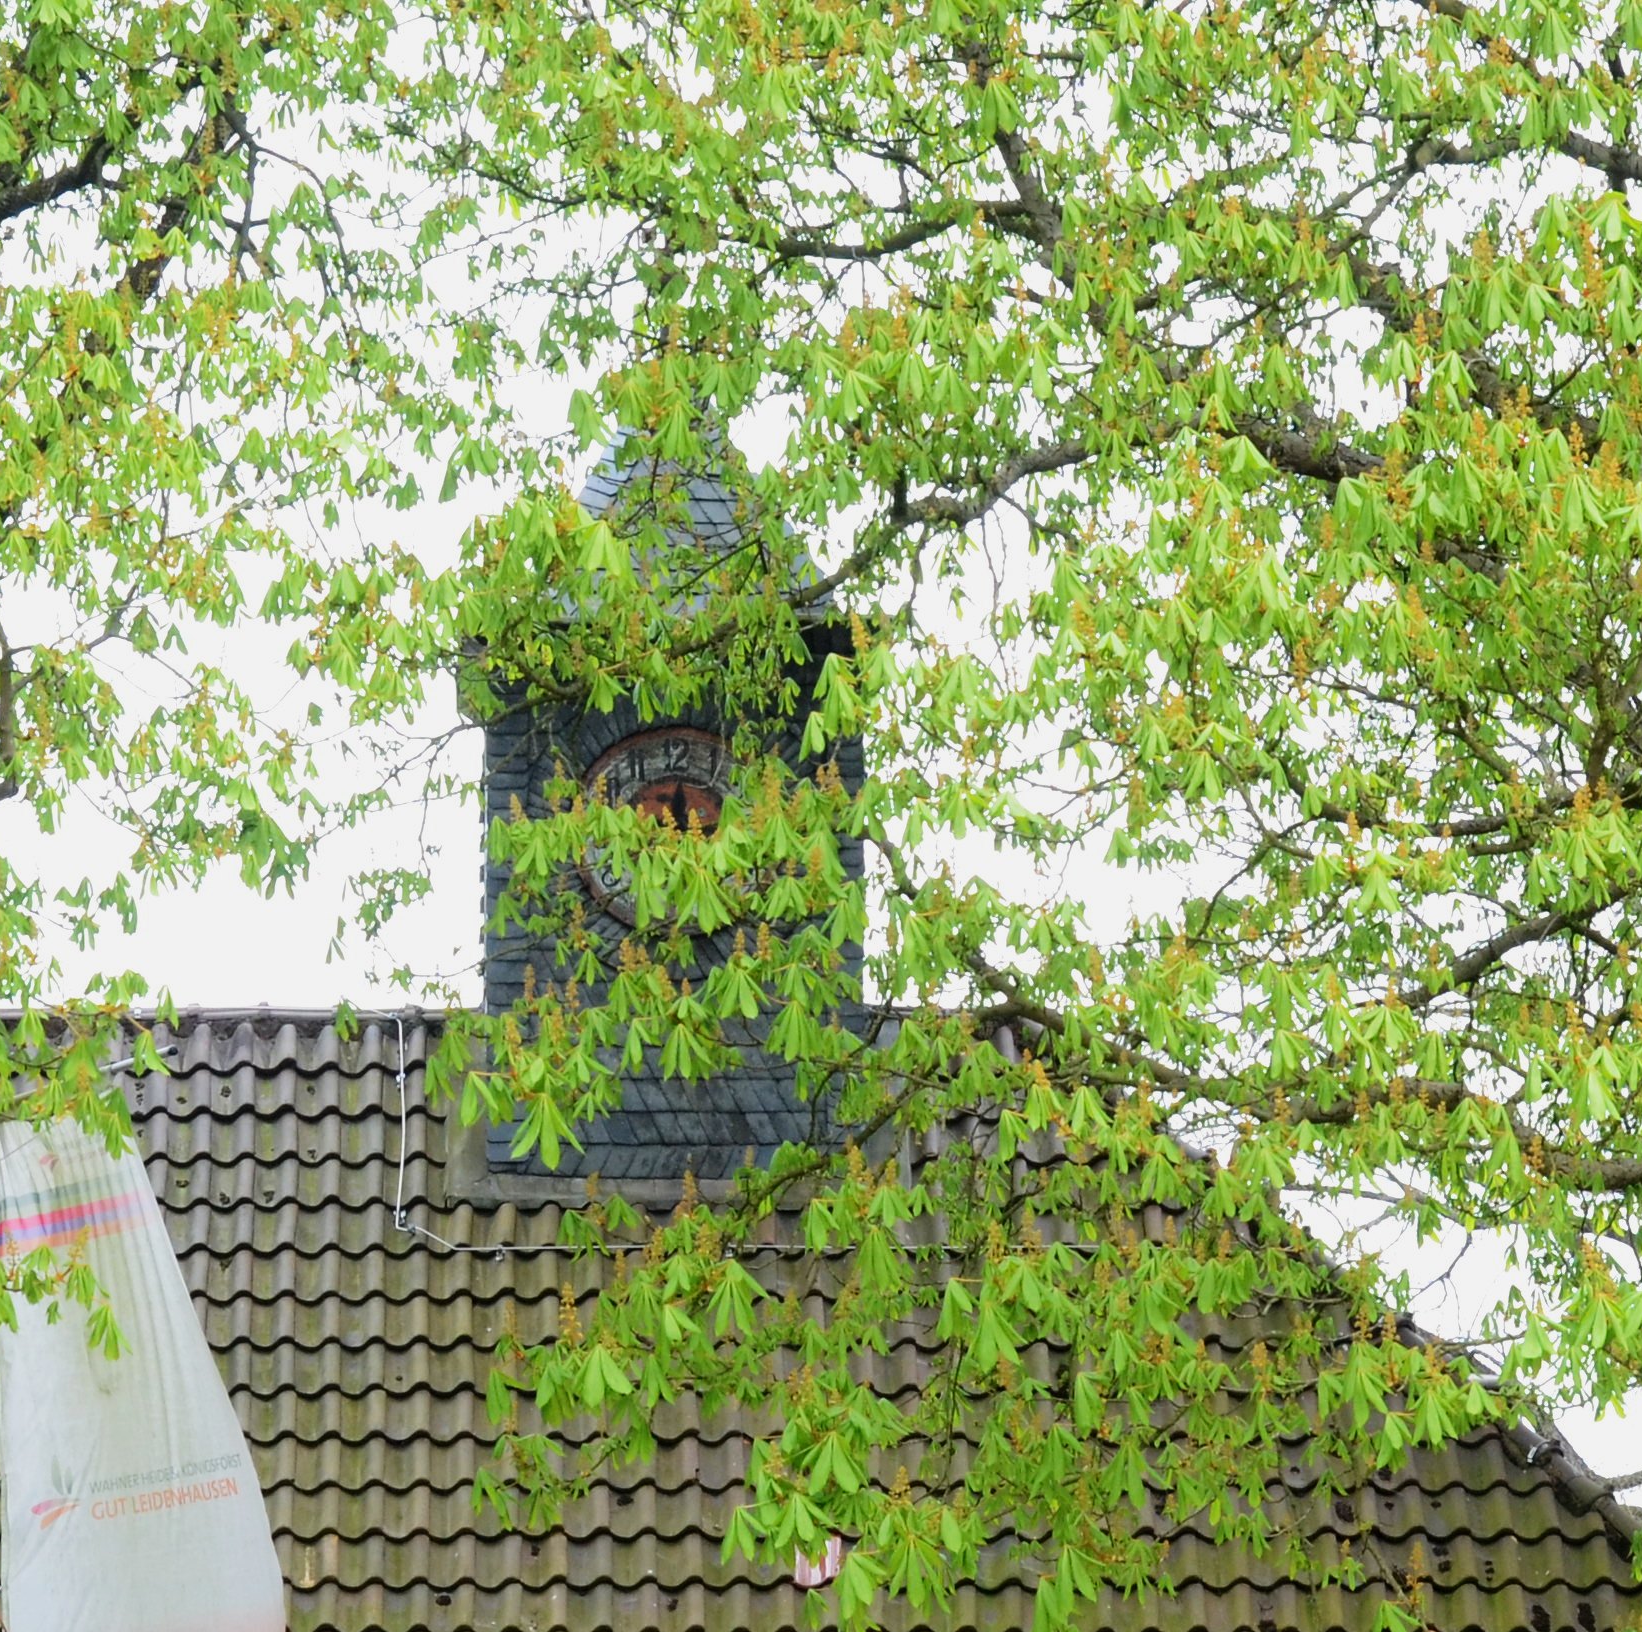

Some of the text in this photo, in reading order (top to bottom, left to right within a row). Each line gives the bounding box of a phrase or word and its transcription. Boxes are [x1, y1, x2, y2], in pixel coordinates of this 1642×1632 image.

[663, 738, 690, 772] 12
[89, 1473, 139, 1494] WAHNER
[91, 1476, 238, 1521] GUT LEIDENHAUSEN
